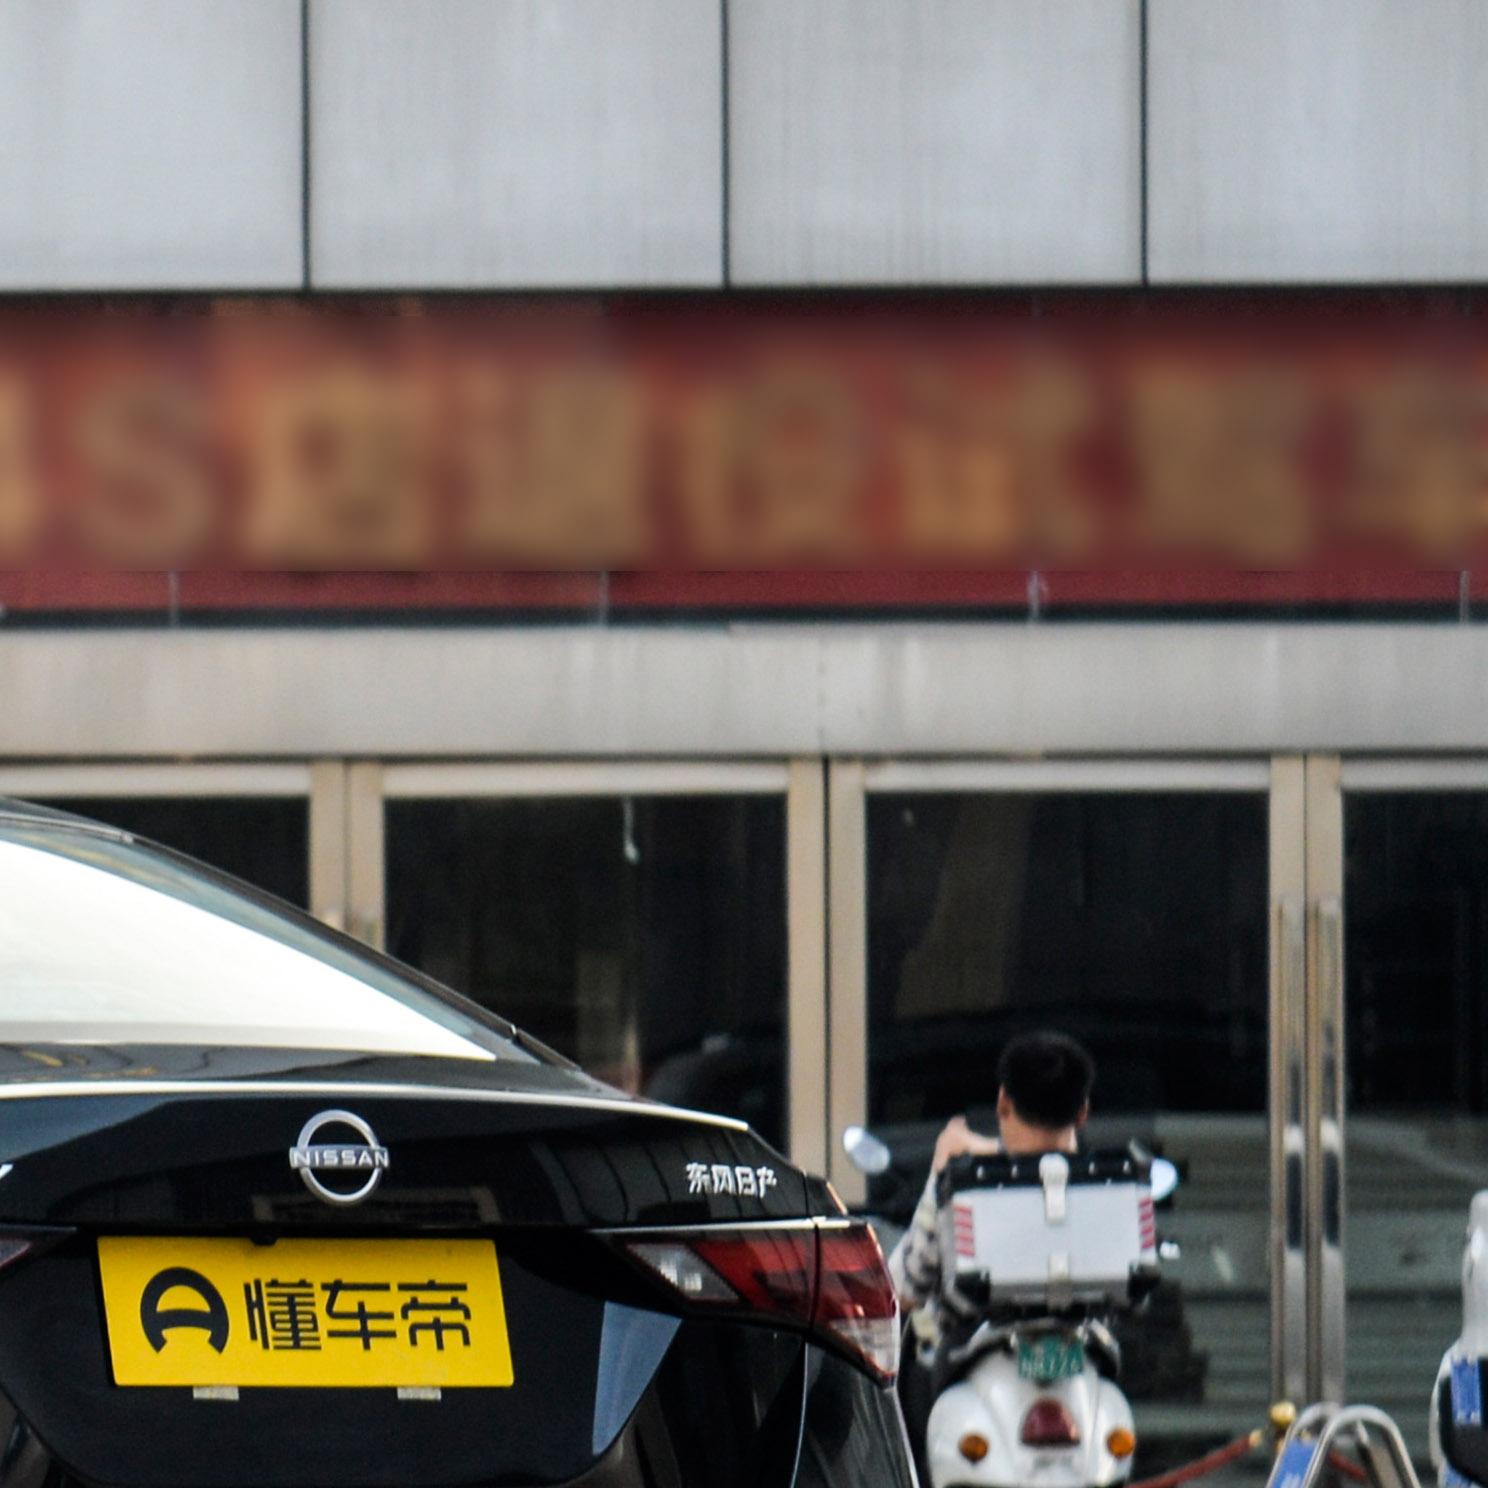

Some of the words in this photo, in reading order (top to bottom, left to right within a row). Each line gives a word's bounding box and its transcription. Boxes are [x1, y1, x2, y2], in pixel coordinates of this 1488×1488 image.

[291, 1147, 390, 1168] NISSAN
[686, 1162, 778, 1198] 东风日产
[243, 1278, 472, 1351] 懂车帝
